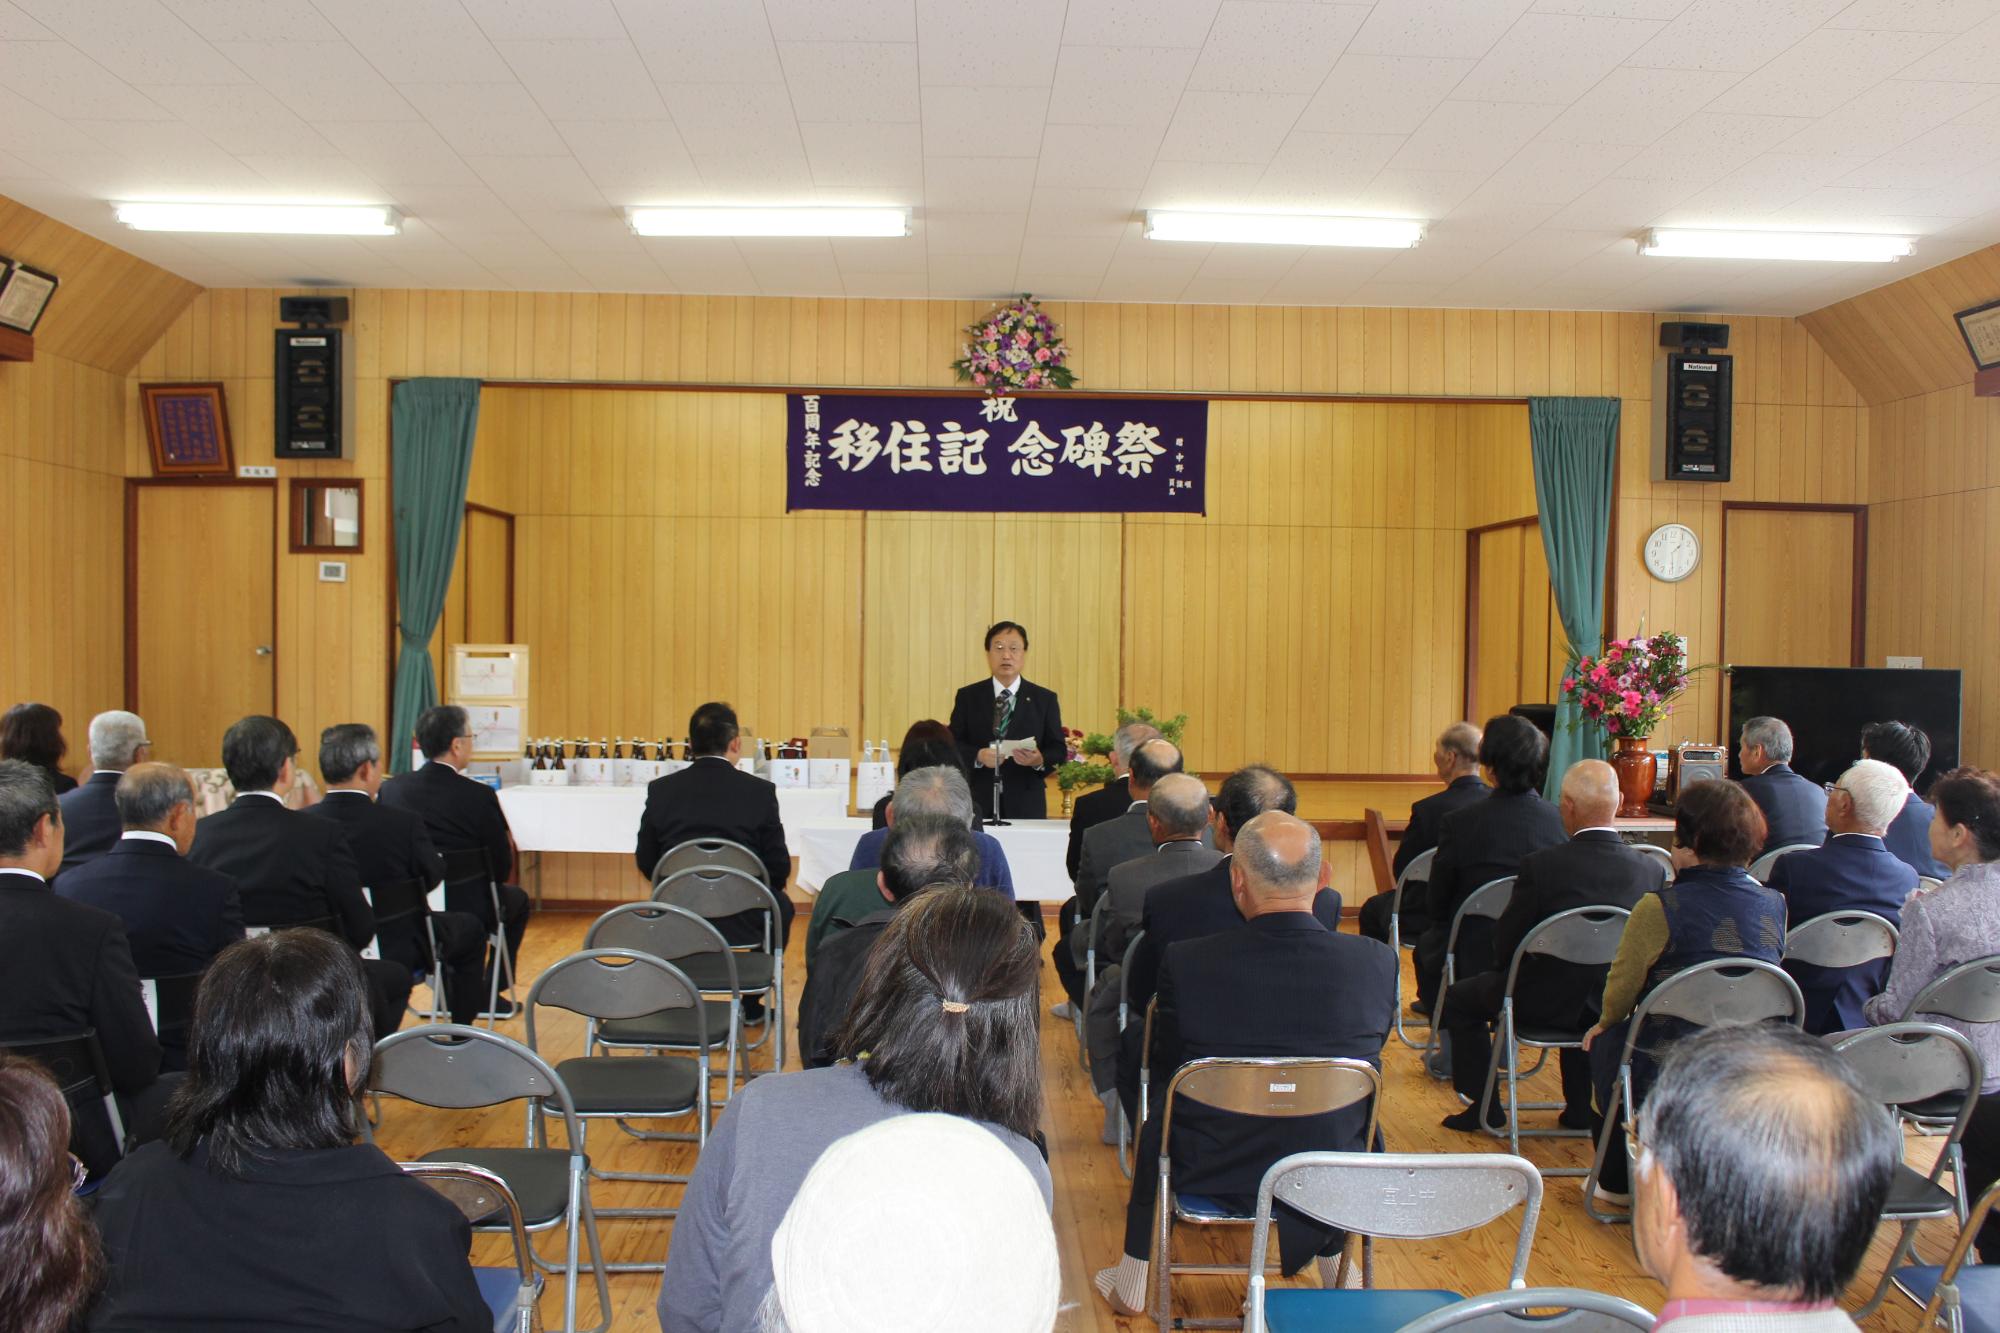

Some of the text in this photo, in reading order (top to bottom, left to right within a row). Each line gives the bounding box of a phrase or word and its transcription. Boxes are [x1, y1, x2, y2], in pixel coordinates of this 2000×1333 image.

[979, 397, 1018, 423] 祝
[802, 395, 823, 487] 百周年記念
[828, 418, 1167, 479] 移住記念碑祭
